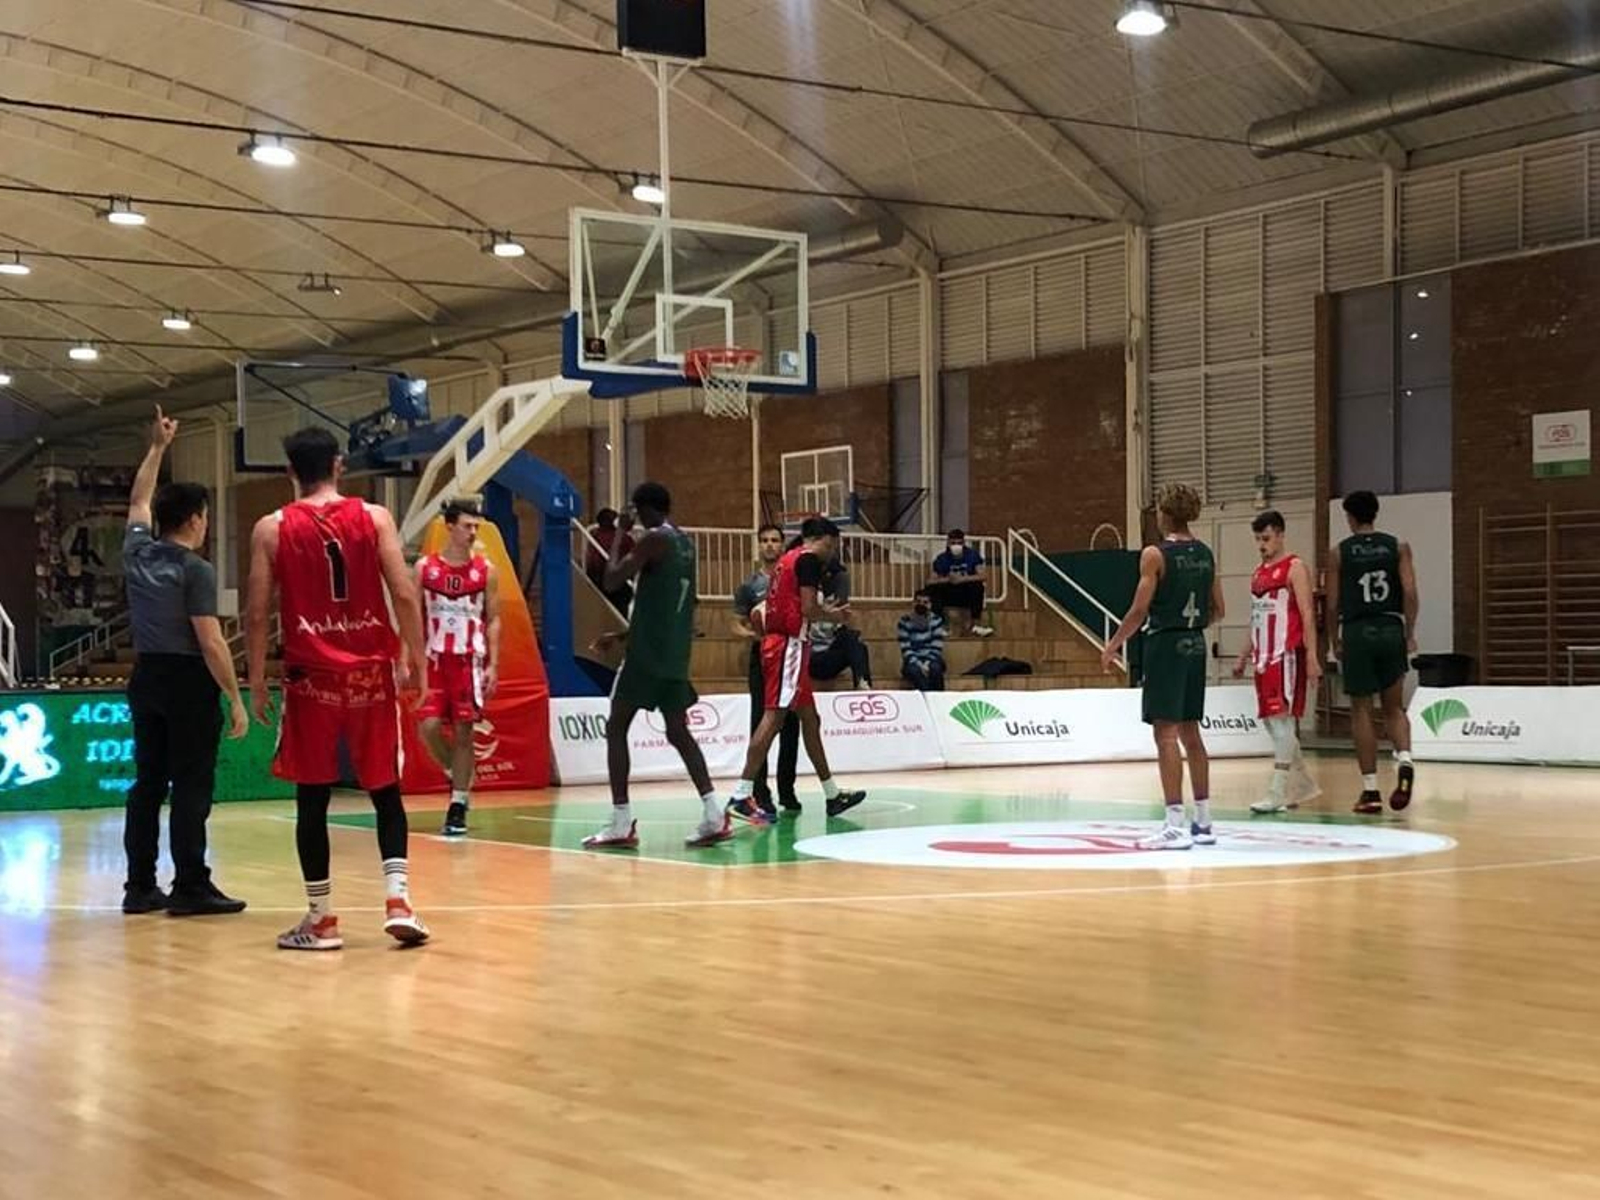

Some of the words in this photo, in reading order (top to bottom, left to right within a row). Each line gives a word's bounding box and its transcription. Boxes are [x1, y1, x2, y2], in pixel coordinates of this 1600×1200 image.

[324, 538, 349, 602] 1
[1358, 569, 1390, 603] 13
[1182, 591, 1200, 628] 4
[850, 700, 887, 716] FQS
[1006, 720, 1070, 739] Unicaja
[1200, 714, 1257, 732] Unicaja
[1461, 720, 1521, 739] Unicaja
